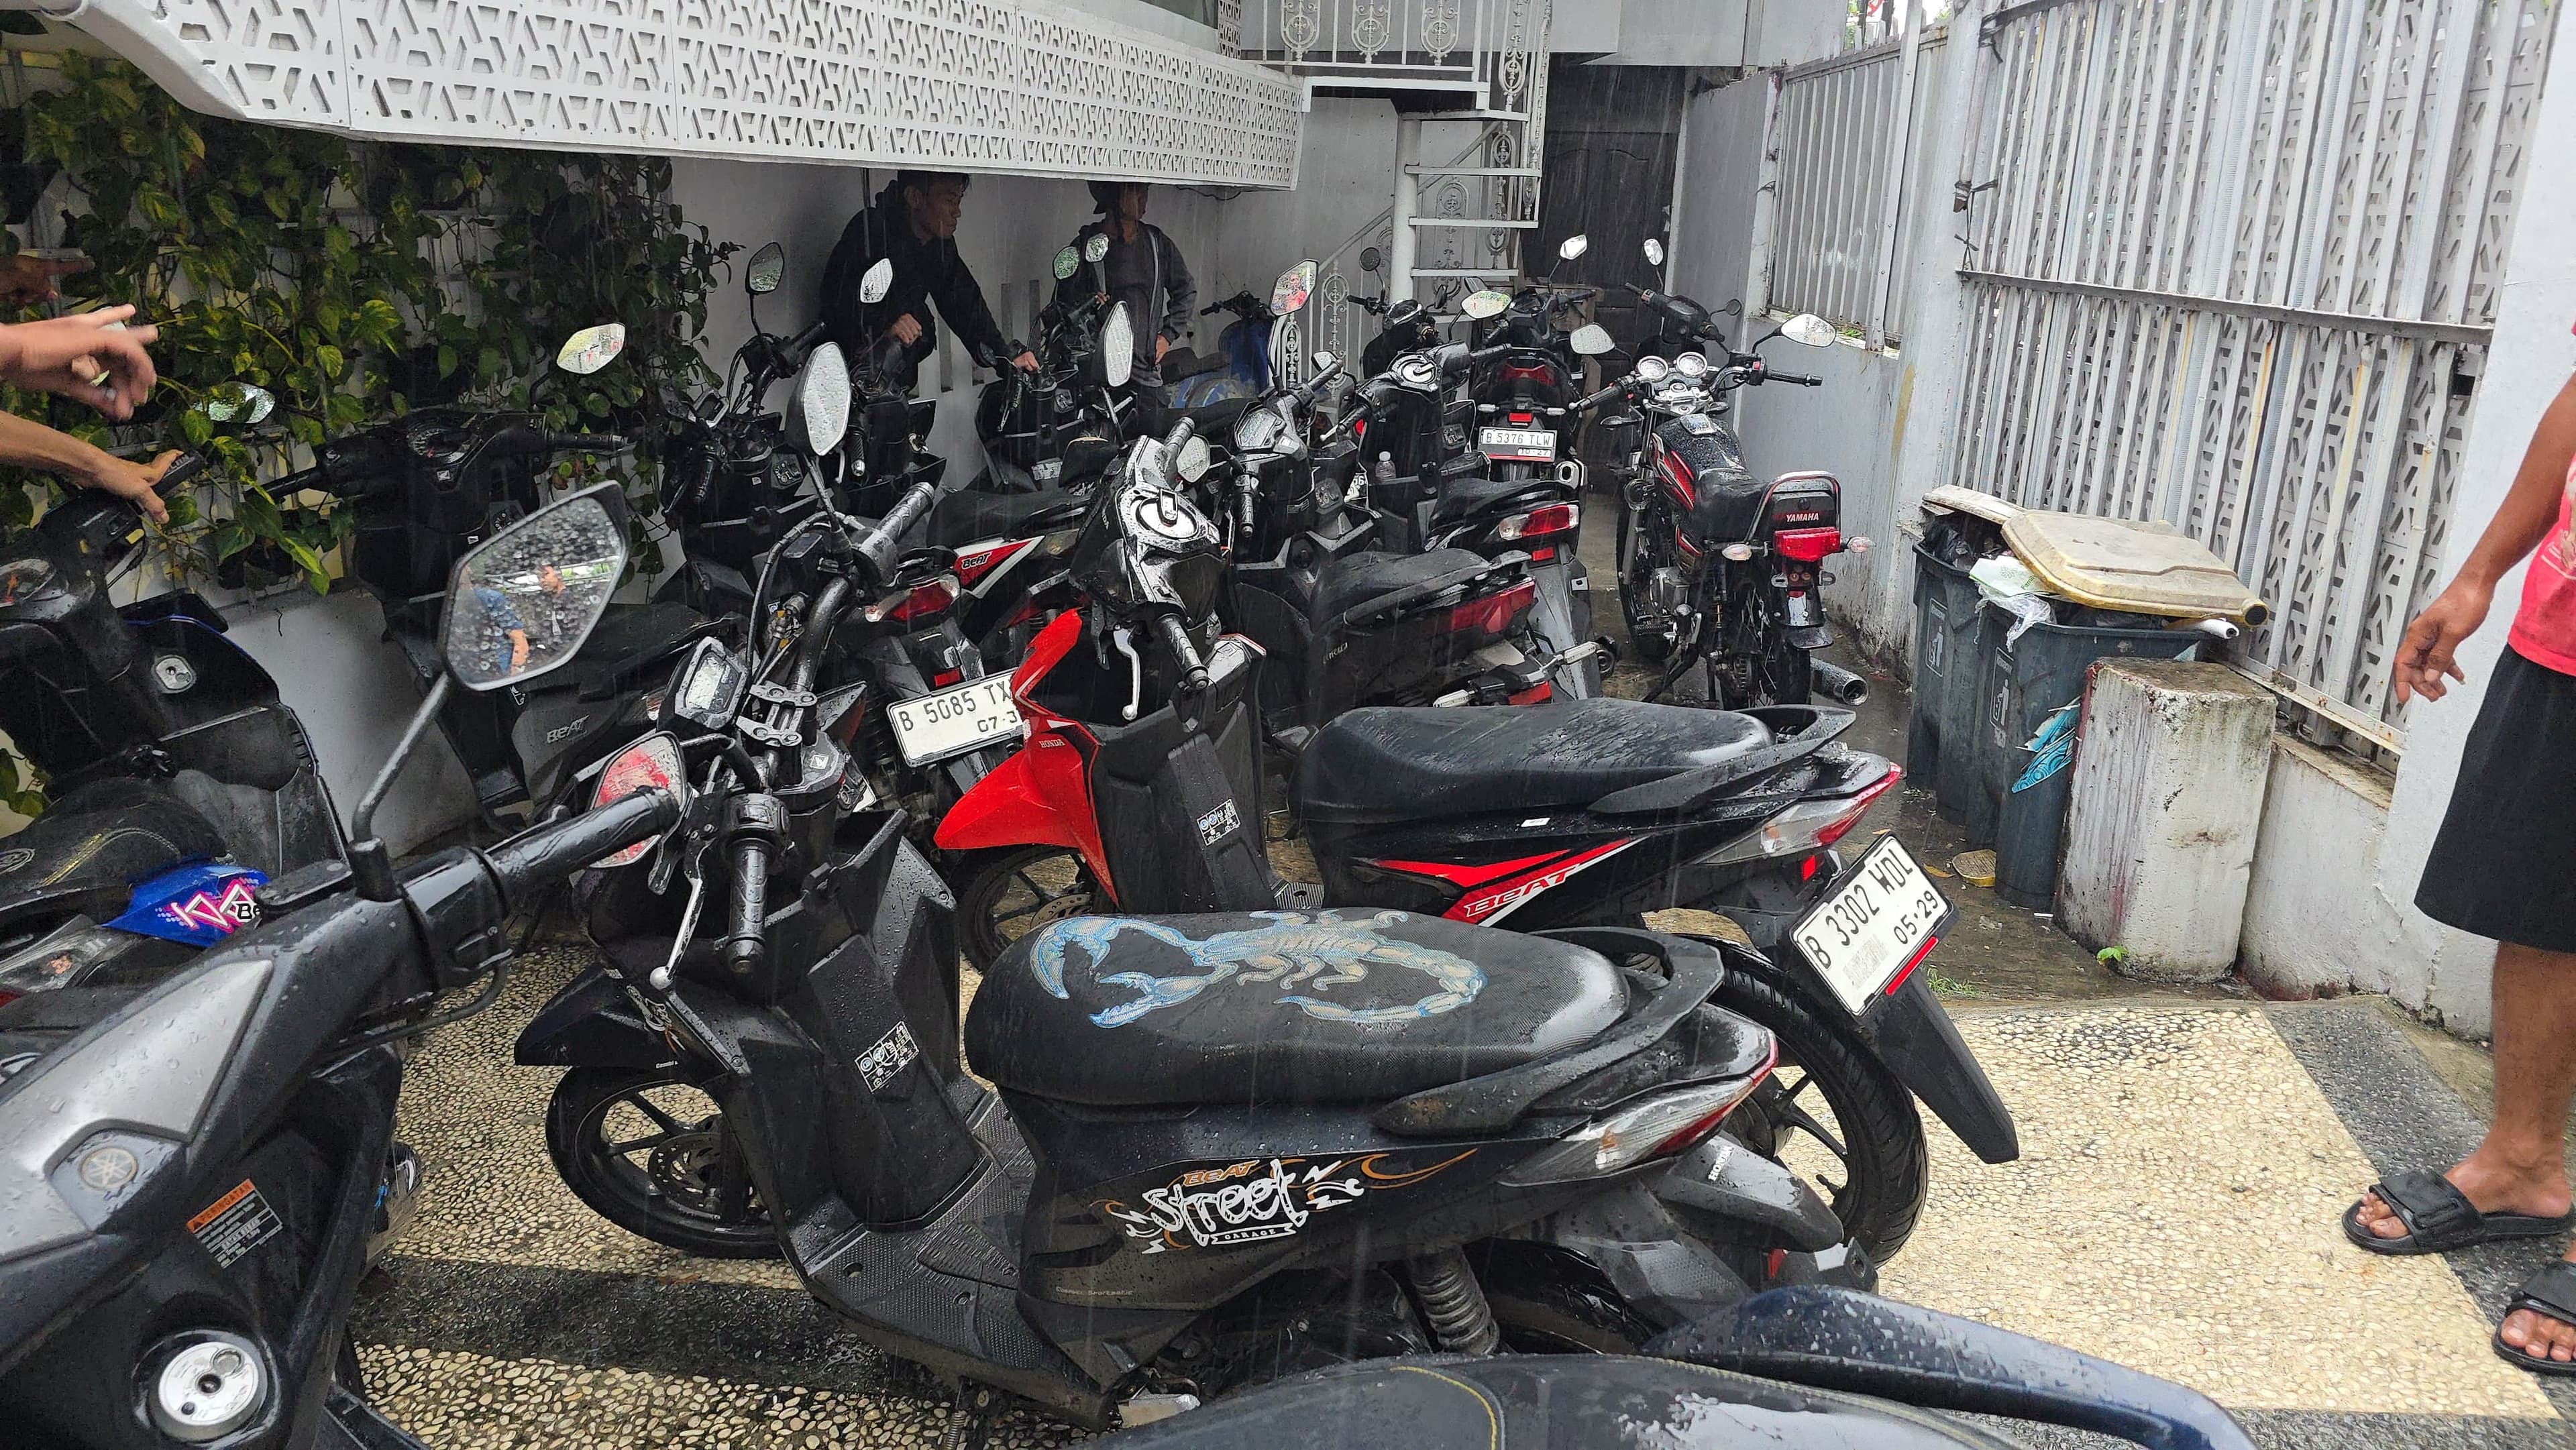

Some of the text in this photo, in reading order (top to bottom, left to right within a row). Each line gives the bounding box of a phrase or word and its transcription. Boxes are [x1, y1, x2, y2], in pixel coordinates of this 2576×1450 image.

[1487, 433, 1550, 445] B 5376 TLW
[1786, 512, 1819, 522] YAMAHA
[898, 679, 1013, 731] B 5085 TX
[1038, 738, 1065, 748] HONDA
[1805, 848, 1913, 970] B 3302 WDL
[200, 1182, 252, 1222] PERINGATAN
[1142, 1158, 1309, 1247] Street
[1223, 1229, 1277, 1241] GARAGE
